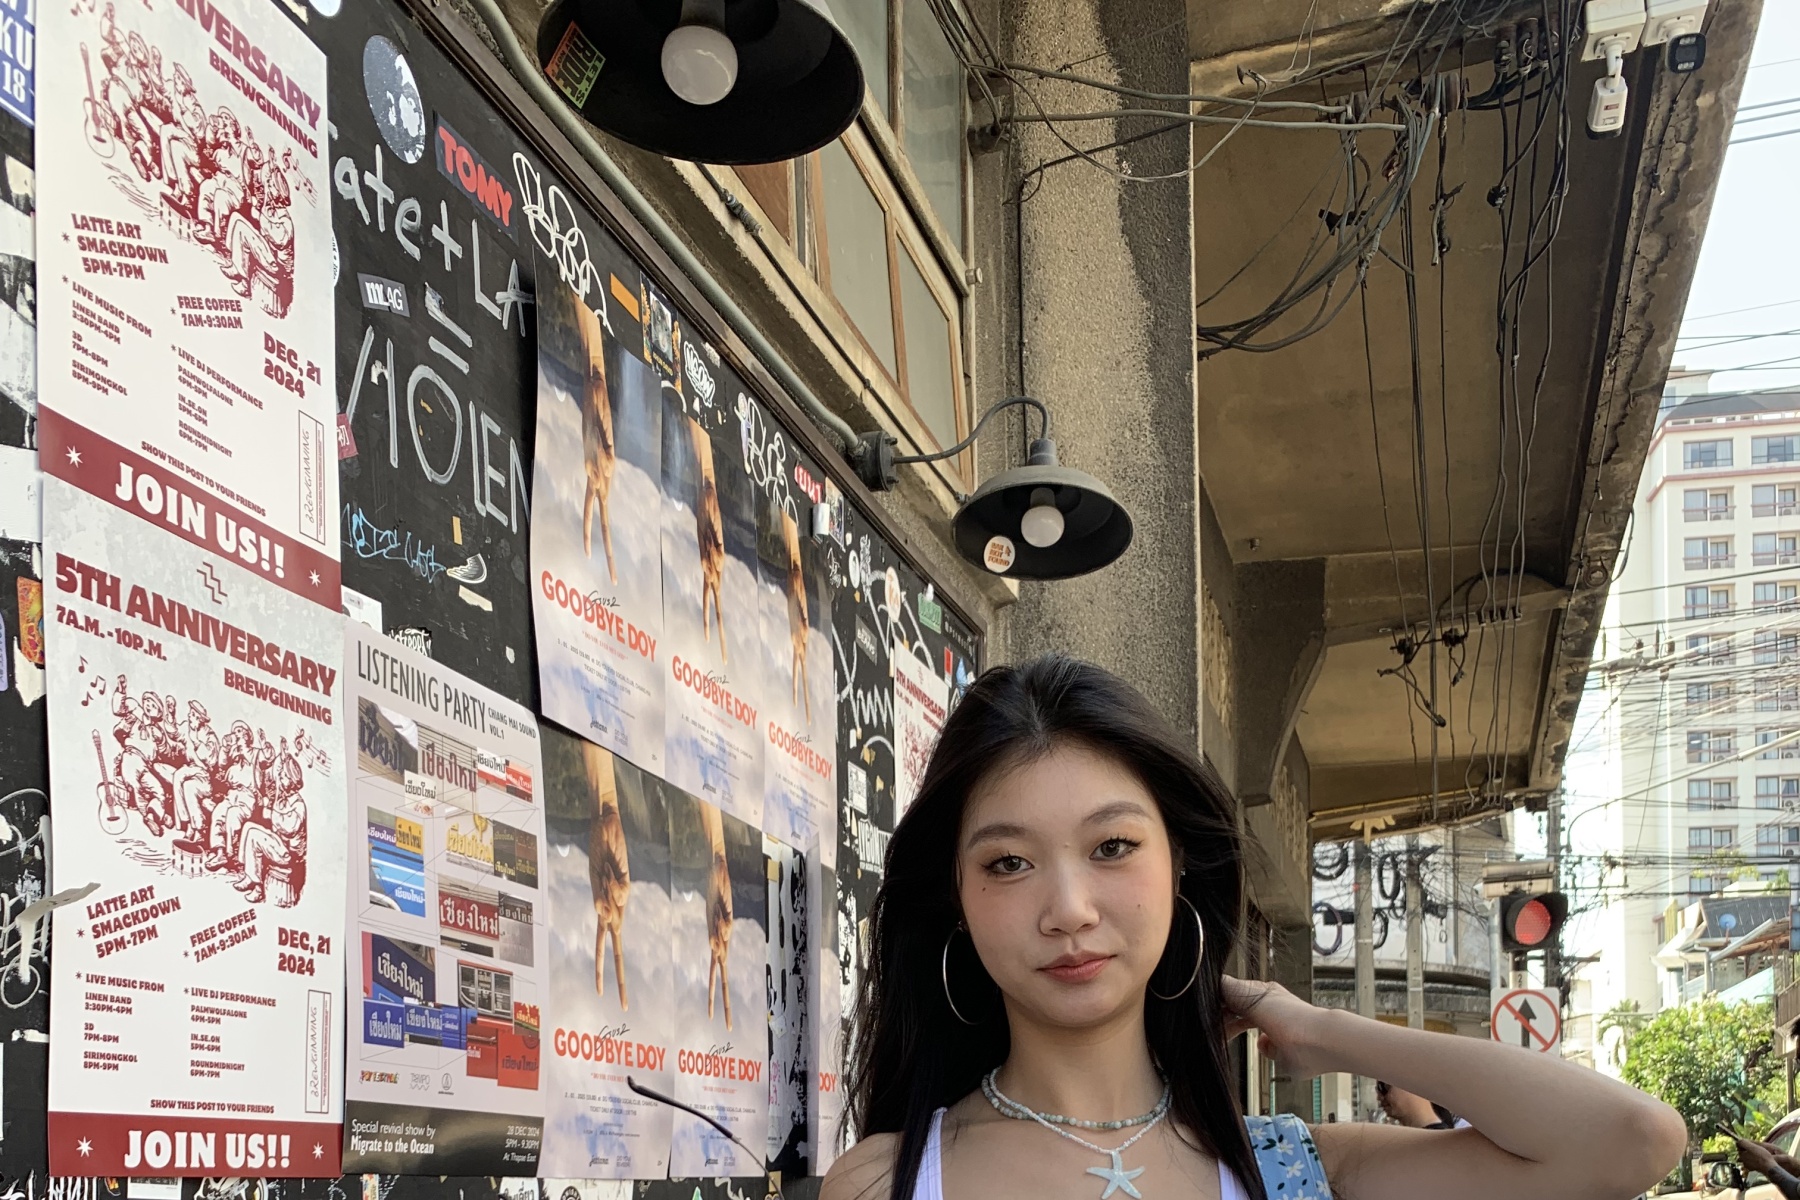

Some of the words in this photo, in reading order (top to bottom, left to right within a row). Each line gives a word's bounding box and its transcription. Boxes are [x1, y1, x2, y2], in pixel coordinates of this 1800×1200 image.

[3, 60, 25, 103] 18
[209, 48, 318, 158] BREWGINNING
[438, 126, 513, 227] TOMY
[71, 213, 113, 236] LATTE
[116, 217, 141, 239] ART
[77, 236, 169, 264] SMACKDOWN
[82, 257, 146, 280] 5PM-7PM
[72, 281, 94, 303] LIVE
[95, 293, 125, 322] MUSIC
[126, 313, 152, 338] FROM
[72, 300, 96, 323] LINEN
[97, 313, 121, 334] BAND
[177, 296, 204, 309] FREE
[205, 298, 242, 312] COFFEE
[72, 309, 121, 345] 3:30PM-4PM
[72, 331, 83, 343] 3D
[181, 313, 243, 329] 7AM-9:30AM
[72, 341, 108, 367] 7PM-8PM
[71, 359, 128, 396] SIRIMONGKOL
[71, 369, 109, 396] 8PM-9PM
[178, 347, 196, 366] LIVE
[196, 359, 205, 372] DJ
[206, 366, 263, 410] PERFORMANCE
[178, 364, 233, 406] PALMWOLFALONE
[263, 357, 305, 399] 2024
[306, 360, 321, 386] 21
[178, 419, 232, 457] ROUNDMIDNIGHT
[141, 441, 167, 462] SHOW
[168, 453, 185, 471] THIS
[186, 462, 205, 482] POST
[205, 472, 215, 486] TO
[215, 477, 235, 499] YOUR
[236, 488, 266, 517] FRIENDS
[116, 461, 206, 540] JOIN
[215, 511, 285, 579] US!!
[56, 552, 121, 613] 5TH
[126, 584, 337, 697] ANNIVERSARY
[56, 605, 105, 639] 7A.M.
[115, 626, 167, 661] 10P.M.
[541, 570, 625, 644] GOODBYE
[627, 622, 657, 663] DOY
[224, 668, 332, 725] BREWGINNING
[357, 639, 439, 712] LISTENING
[444, 682, 486, 734] PARTY
[672, 655, 733, 716] GOODBYE
[735, 699, 757, 730] DOY
[488, 706, 507, 726] CHIANG
[508, 716, 518, 731] MAI
[518, 722, 537, 739] SOUND
[769, 721, 815, 770] GOODBYE
[815, 754, 832, 781] DOY
[86, 893, 129, 920] LATTE
[130, 885, 155, 906] ART
[91, 896, 182, 939] SMACKDOWN
[96, 925, 159, 959] 5PM-7PM
[190, 925, 217, 947] FREE
[218, 908, 257, 934] COFFEE
[194, 925, 258, 963] 7AM-9:30AM
[317, 935, 331, 955] 21
[278, 952, 316, 977] 2024
[85, 973, 106, 985] LIVE
[107, 976, 138, 990] MUSIC
[138, 980, 165, 993] FROM
[85, 992, 109, 1003] LINEN
[109, 994, 132, 1005] BAND
[191, 987, 209, 998] LIVE
[209, 989, 219, 1000] DJ
[220, 991, 277, 1007] PERFORMANCE
[84, 1001, 133, 1015] 3:30PM-4PM
[190, 1004, 248, 1019] PALMWOLFALONE
[190, 1014, 221, 1025] 4PM-5PM
[83, 1032, 119, 1044] 7PM-8PM
[84, 1023, 94, 1031] 3D
[83, 1051, 138, 1063] SIRIMONGKOL
[190, 1042, 221, 1052] 5PM-6PM
[554, 1027, 633, 1068] GOODBYE
[636, 1044, 666, 1072] DOY
[83, 1061, 119, 1071] 8PM-9PM
[190, 1059, 245, 1071] ROUNDMIDNIGHT
[190, 1068, 220, 1078] 6PM-7PM
[678, 1048, 736, 1080] GOODBYE
[738, 1059, 762, 1083] DOY
[150, 1099, 176, 1110] SHOW
[177, 1100, 195, 1111] THIS
[197, 1101, 216, 1112] POST
[216, 1102, 225, 1112] TO
[226, 1103, 246, 1113] YOUR
[247, 1104, 275, 1114] FRIENDS
[351, 1118, 379, 1134] Special
[380, 1122, 403, 1134] revival
[405, 1123, 424, 1136] show
[426, 1125, 436, 1140] by
[351, 1135, 382, 1155] Migrate
[384, 1139, 394, 1152] to
[395, 1138, 409, 1153] the
[410, 1139, 434, 1154] Ocean
[124, 1130, 217, 1169] JOIN
[226, 1133, 291, 1169] US!!
